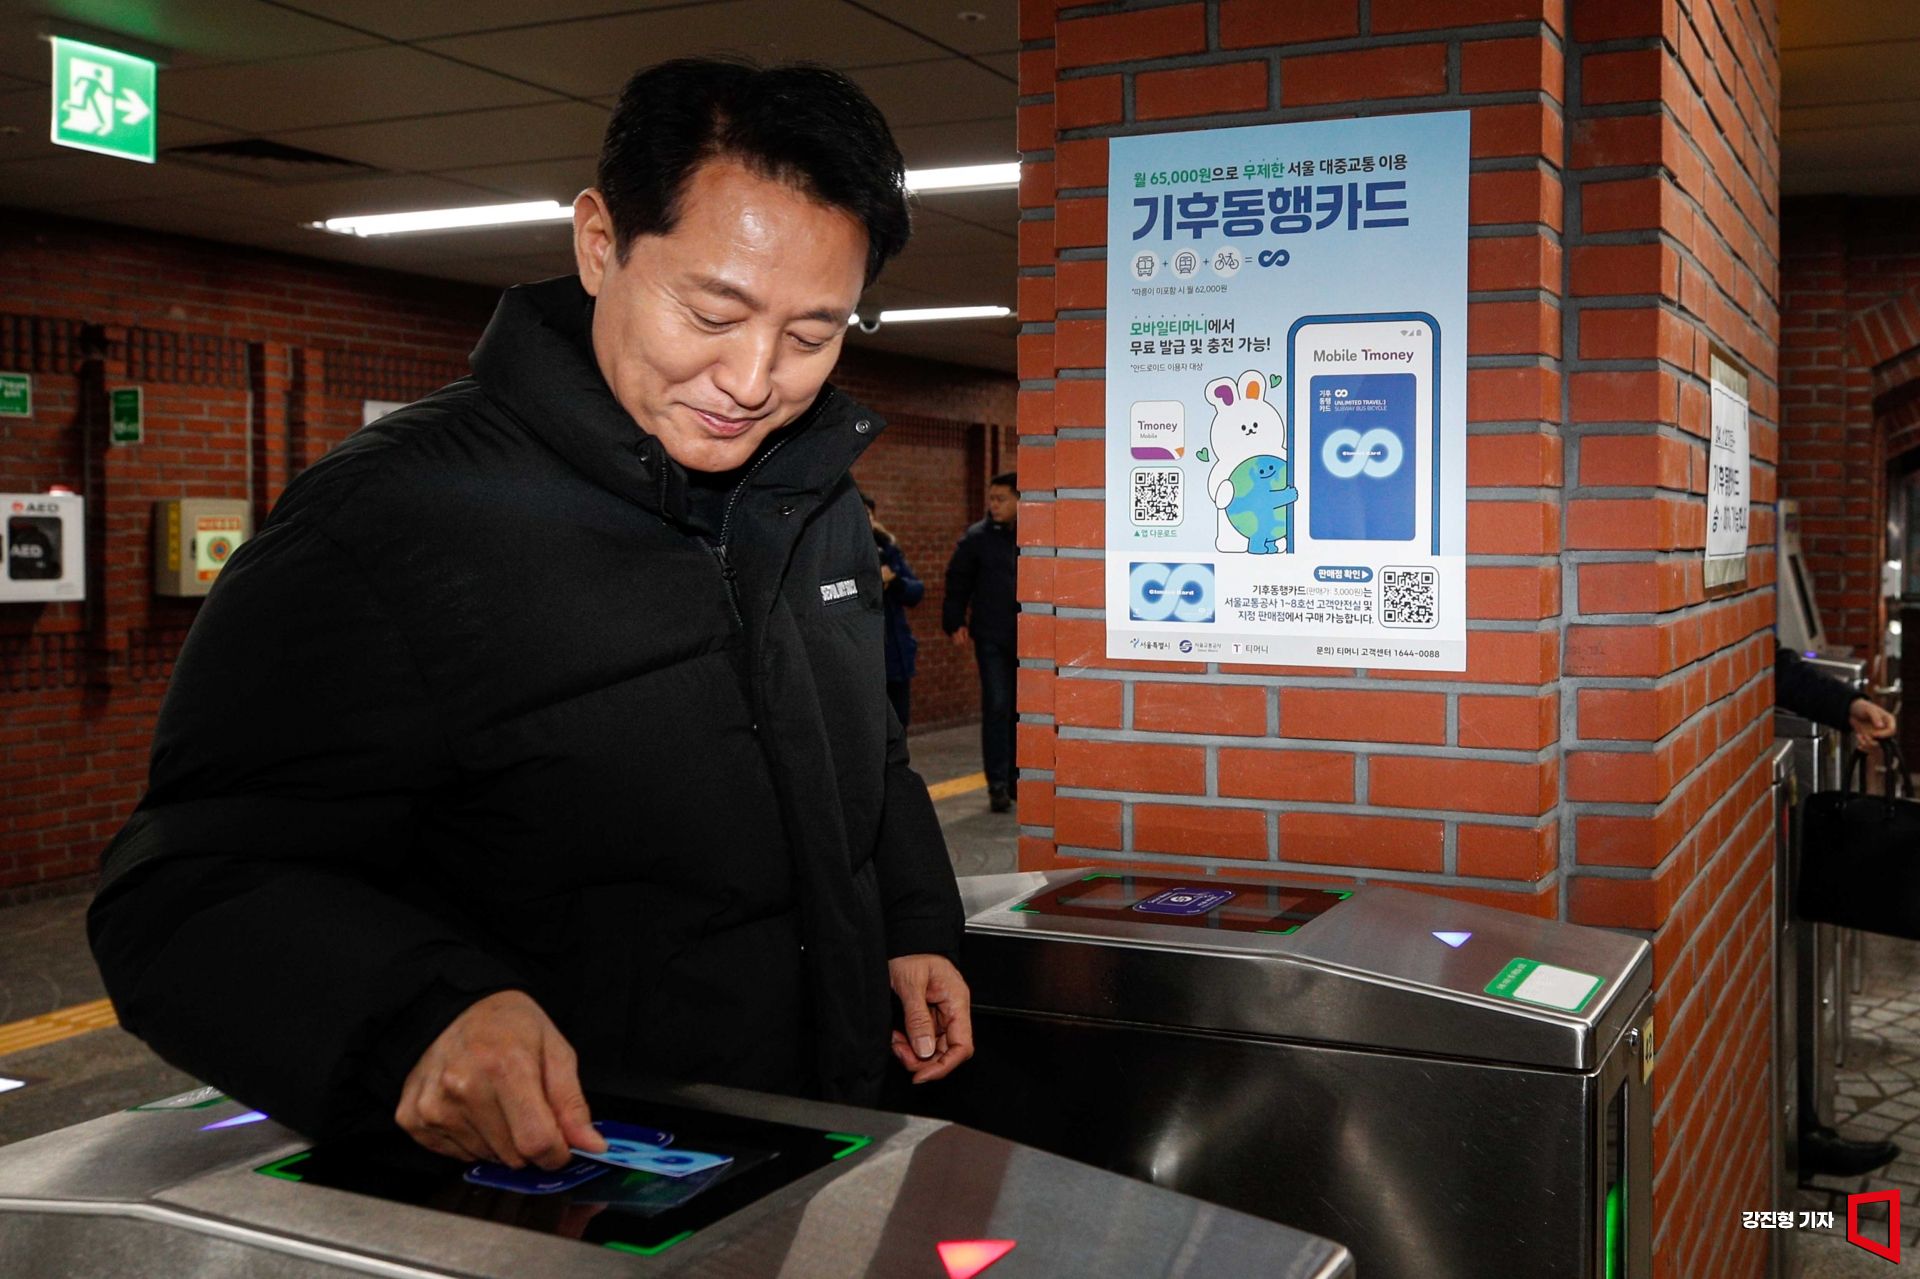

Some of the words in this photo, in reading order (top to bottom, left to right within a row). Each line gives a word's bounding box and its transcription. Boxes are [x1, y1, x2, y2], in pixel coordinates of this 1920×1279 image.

[1134, 172, 1146, 188] 월
[1150, 166, 1239, 186] 65,000원으로
[1243, 162, 1285, 180] 무제한
[1288, 160, 1315, 177] 서울
[1320, 156, 1376, 176] 대중교통
[1379, 154, 1408, 171] 이용
[1132, 180, 1409, 241] 기후동행카드
[1178, 286, 1185, 295] 시
[1195, 284, 1228, 294] 62,000원
[1130, 318, 1235, 336] 모바일티머니에서
[1130, 340, 1156, 356] 무료
[1160, 339, 1186, 355] 발급
[1190, 339, 1203, 354] 및
[1207, 338, 1234, 354] 충전
[1238, 337, 1271, 352] 가능!
[1313, 348, 1358, 362] Mobile
[1361, 348, 1414, 363] Tmoney
[1167, 363, 1188, 372] 이용자
[1189, 362, 1203, 371] 대상
[1137, 420, 1178, 432] Tmoney
[26, 503, 59, 512] AED
[1150, 529, 1178, 538] 다운로드
[11, 544, 43, 559] AED
[1318, 568, 1343, 579] 판매점
[1344, 568, 1361, 579] 확인
[1224, 597, 1277, 609] 서울교통공사
[1280, 598, 1315, 609] 1~8호선
[1316, 600, 1361, 611] 고객안전실
[1363, 600, 1373, 612] 및
[1238, 611, 1256, 621] 지정
[1258, 611, 1303, 623] 판매점에서
[1305, 612, 1324, 623] 구매
[1326, 612, 1374, 625] 가능합니다.
[1245, 644, 1269, 654] 티머니
[1316, 646, 1335, 656] 문의)
[1337, 646, 1359, 656] 티머니
[1361, 647, 1392, 658] 고객센터
[1394, 649, 1440, 658] 1644-0088
